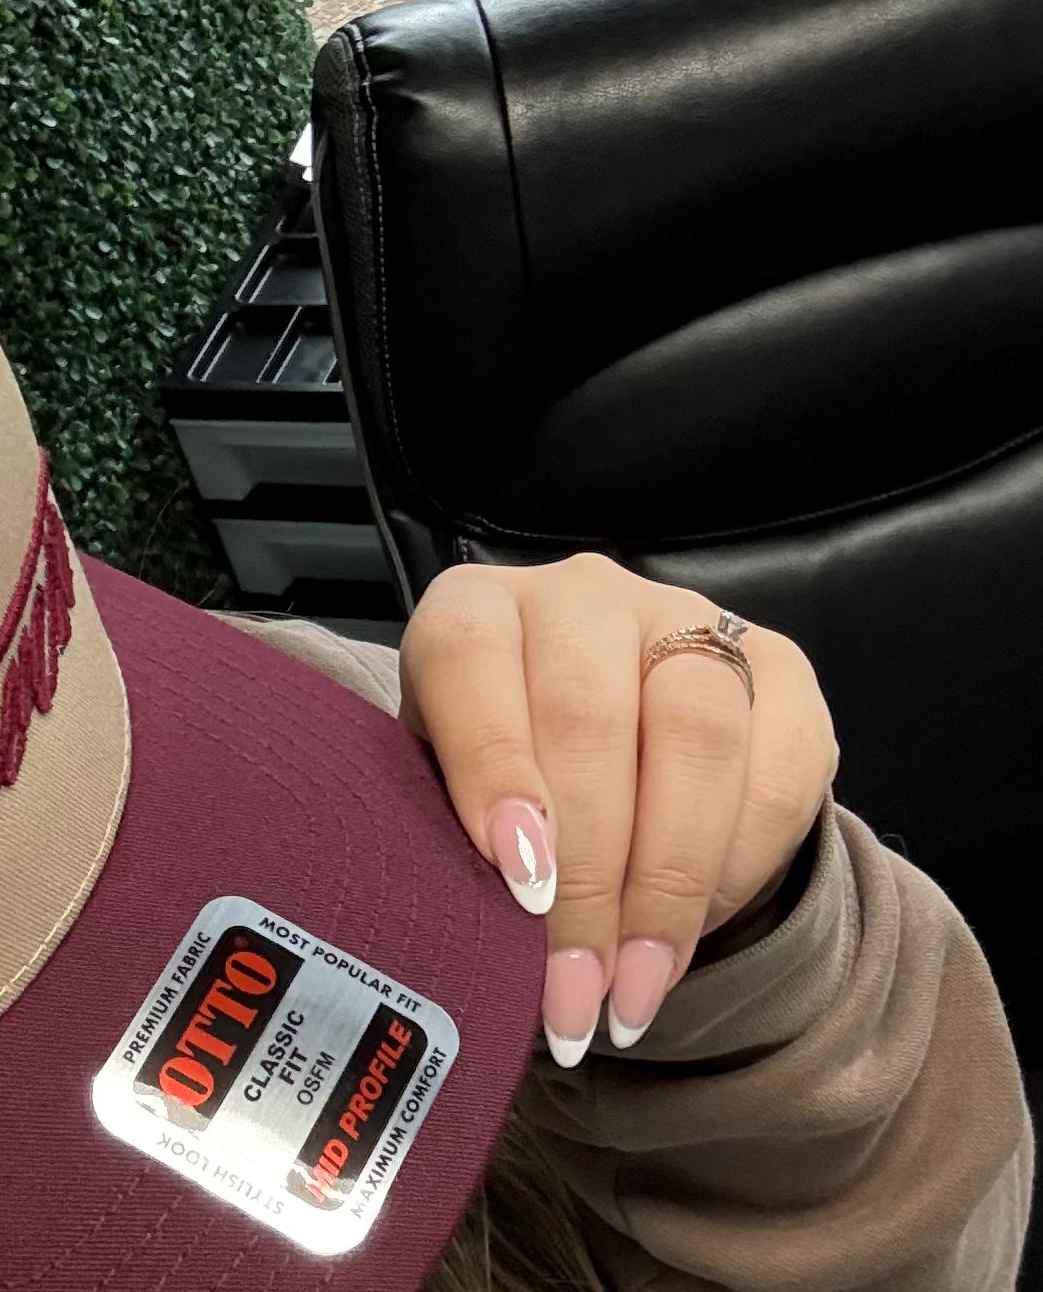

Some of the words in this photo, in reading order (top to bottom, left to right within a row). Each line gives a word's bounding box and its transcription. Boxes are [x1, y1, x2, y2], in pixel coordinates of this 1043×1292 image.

[124, 986, 177, 1064] PREMIUM
[172, 931, 212, 990] FABRIC
[258, 917, 310, 950] MOST
[312, 948, 392, 997] POPULAR
[396, 990, 421, 1014] FIT
[159, 952, 276, 1108] OTTO
[244, 1010, 304, 1103] CLASSIC
[280, 1052, 309, 1085] FIT
[297, 1052, 335, 1106] OSFM
[305, 1138, 349, 1203] MID
[339, 1019, 413, 1142] PROFILE
[158, 1132, 210, 1173] LOOK
[351, 1126, 407, 1219] MAXIMUM
[401, 1047, 448, 1123] COMFORT
[213, 1166, 285, 1215] STYLISH
